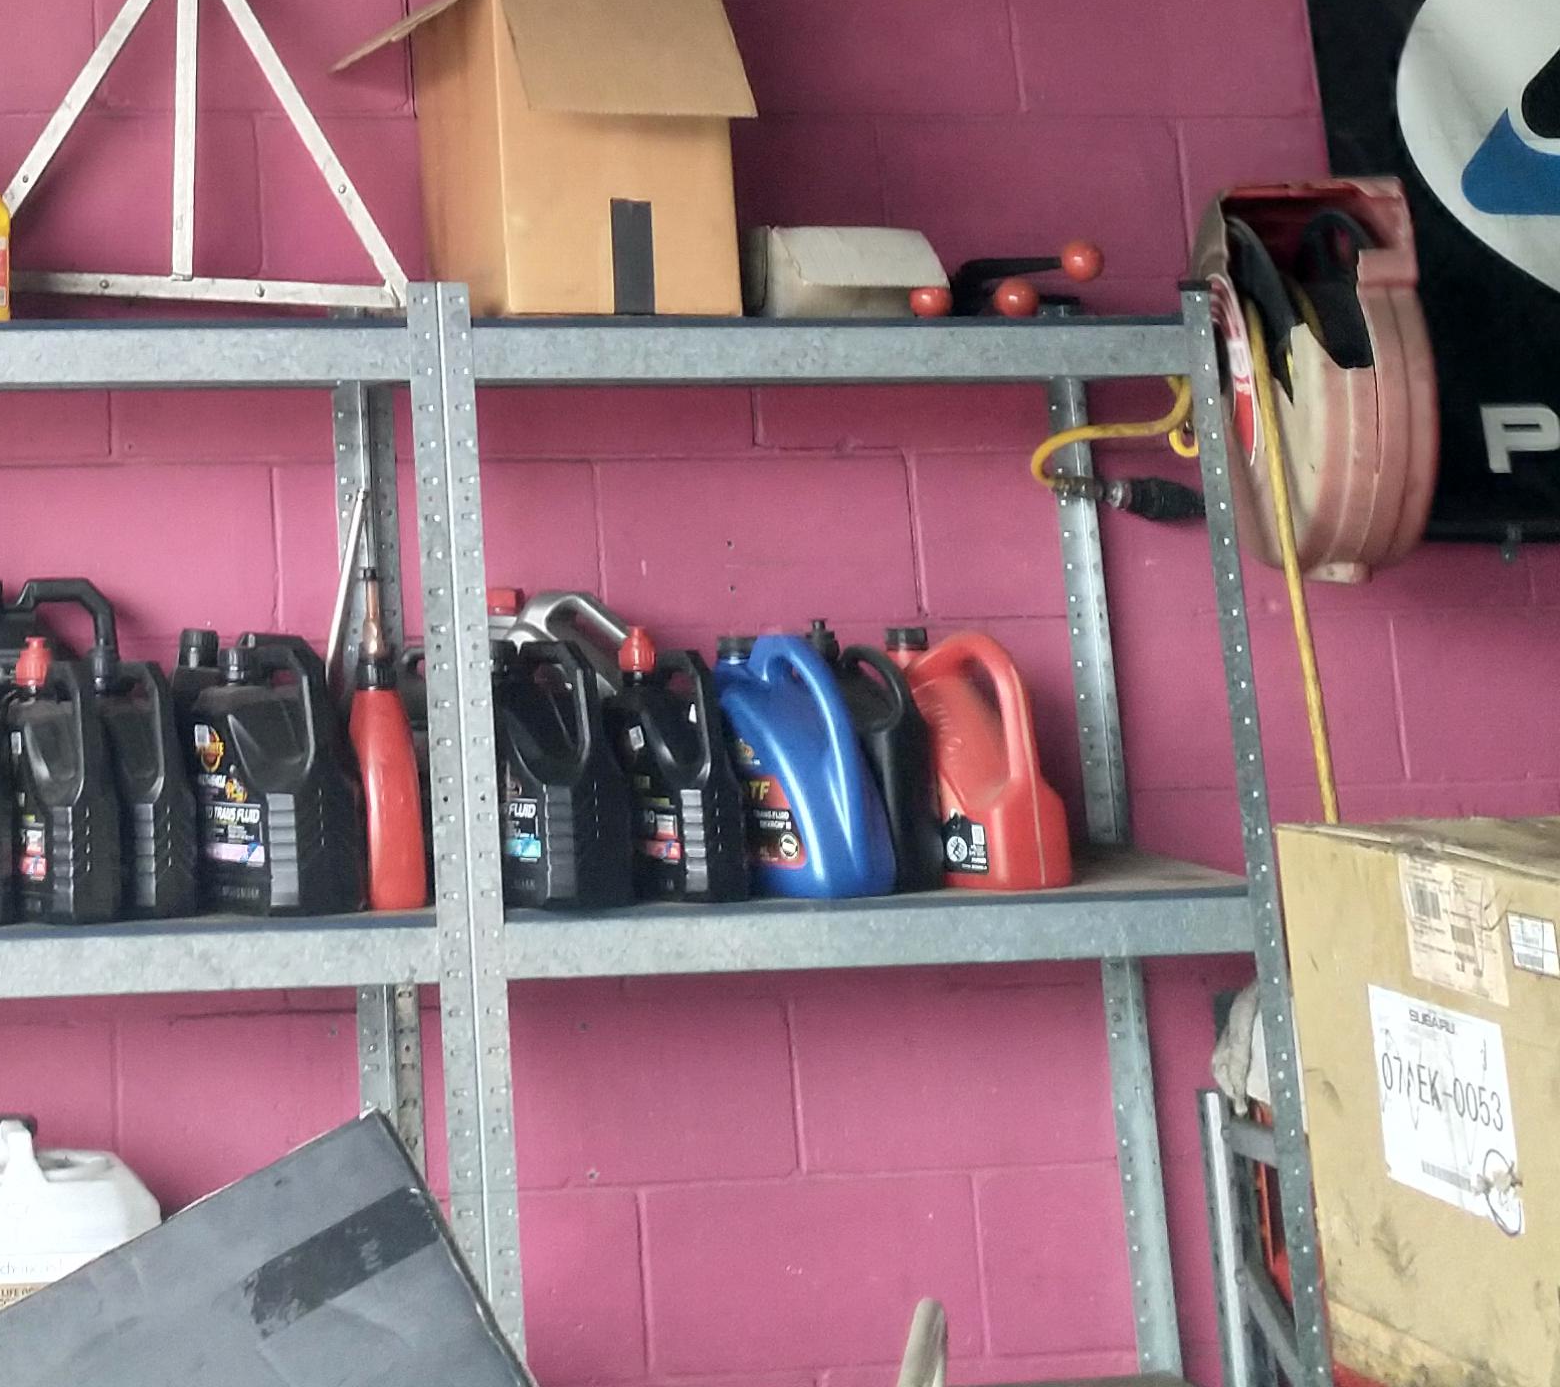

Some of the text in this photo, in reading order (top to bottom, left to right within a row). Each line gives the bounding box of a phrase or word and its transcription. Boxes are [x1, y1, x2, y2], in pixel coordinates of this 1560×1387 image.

[237, 808, 260, 824] FLUID
[509, 803, 536, 818] FLUID
[1409, 1008, 1456, 1034] SUBARU
